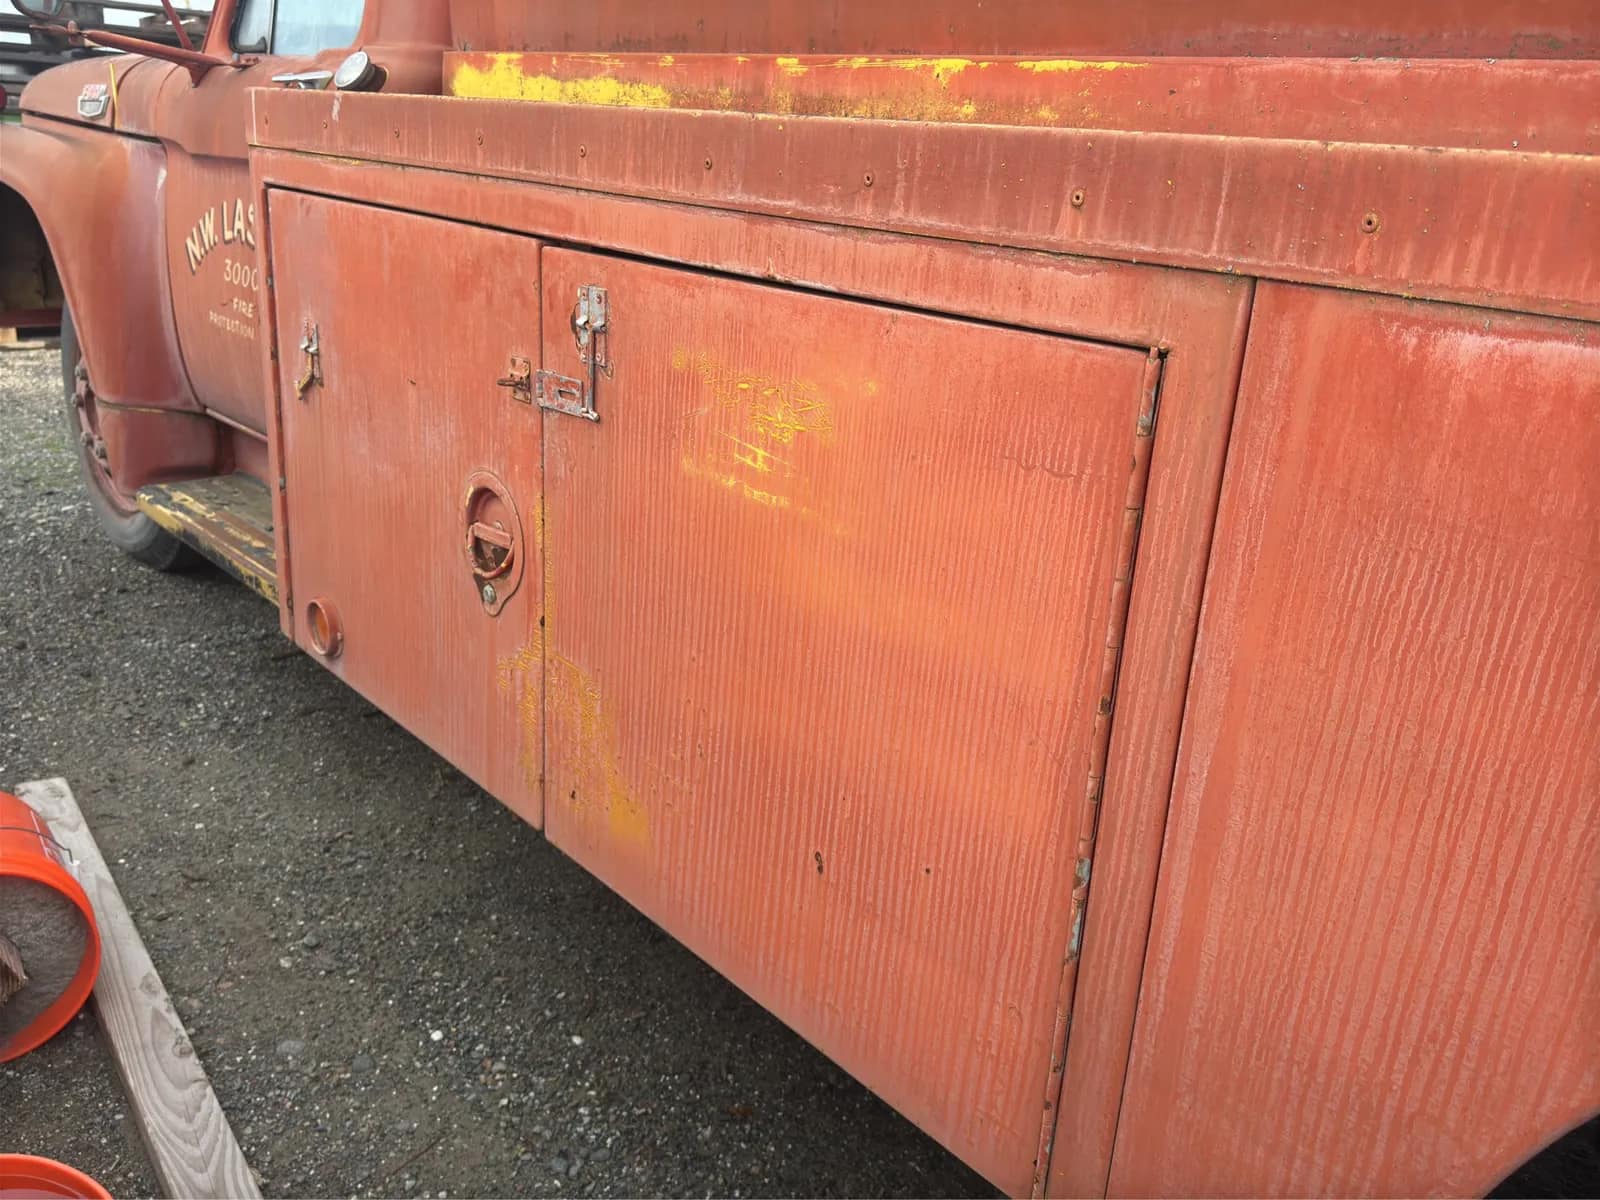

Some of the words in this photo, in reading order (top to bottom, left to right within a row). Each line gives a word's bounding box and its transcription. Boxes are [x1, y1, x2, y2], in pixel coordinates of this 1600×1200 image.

[186, 207, 219, 273] N.W.
[232, 297, 254, 318] FIRE
[209, 310, 255, 340] PROTECTION
